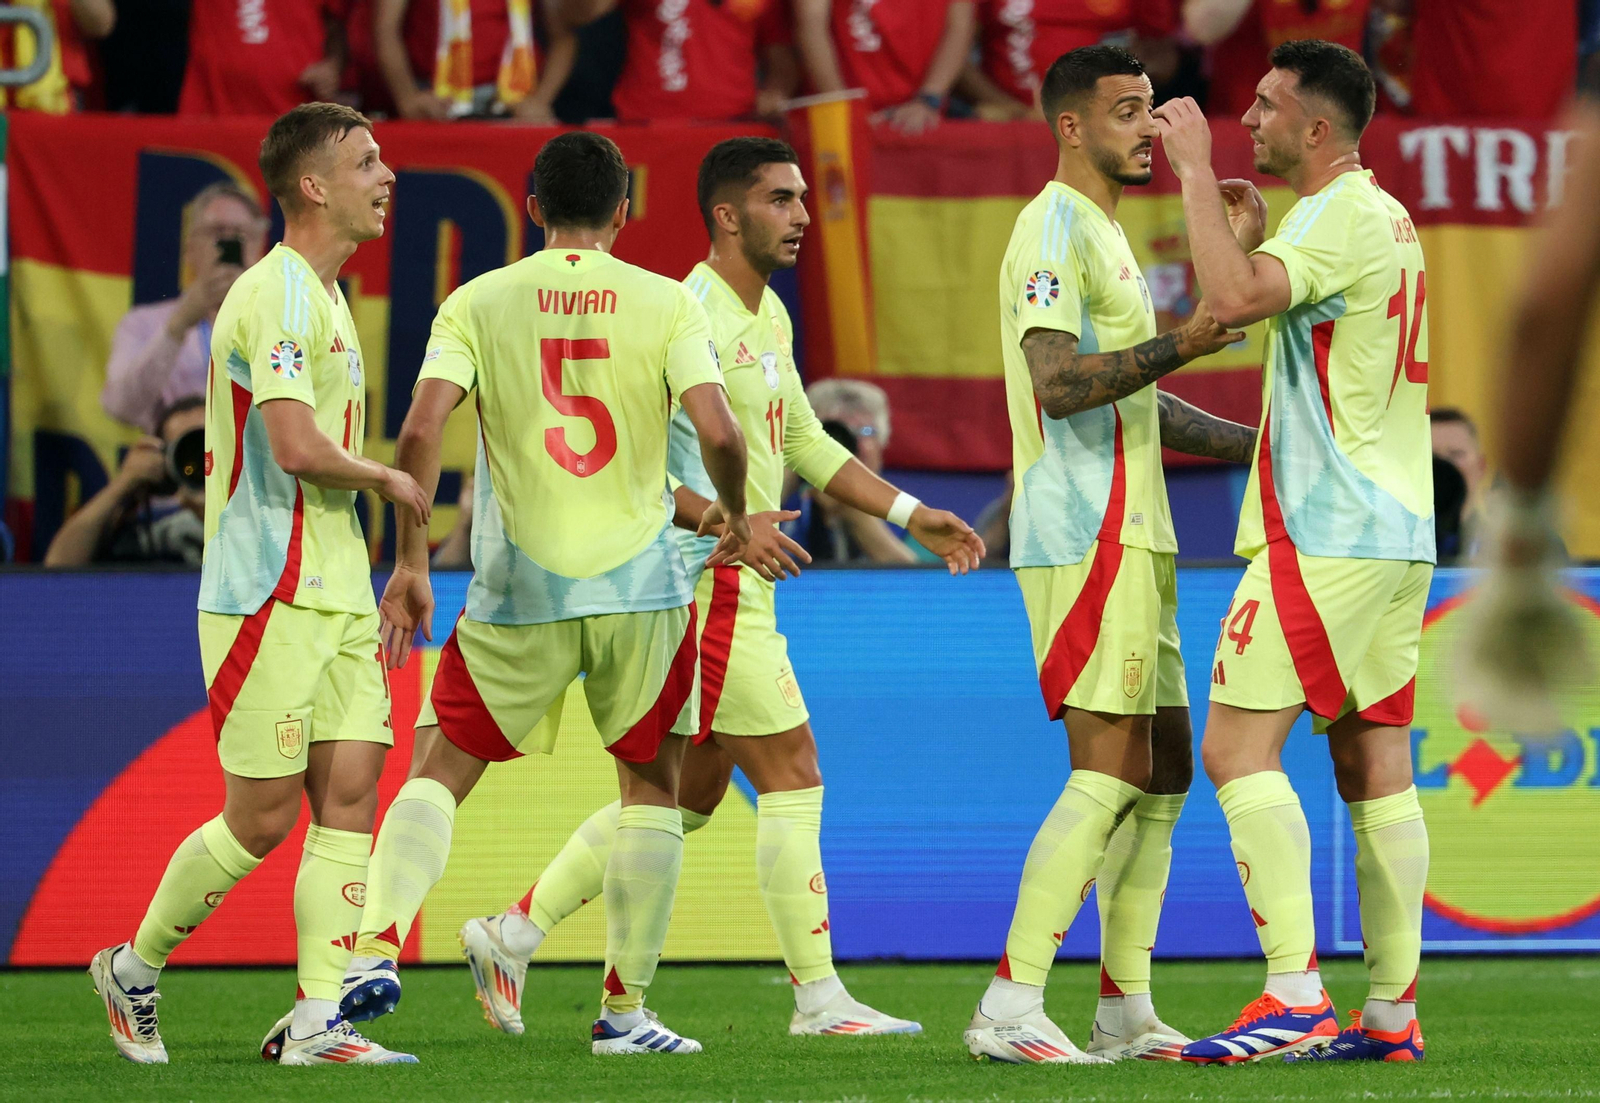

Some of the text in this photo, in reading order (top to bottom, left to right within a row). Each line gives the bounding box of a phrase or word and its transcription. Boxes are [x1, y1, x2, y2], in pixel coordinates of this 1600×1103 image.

[538, 288, 617, 315] VIVIAN
[540, 337, 618, 478] 5
[766, 398, 784, 455] 11
[994, 1031, 1039, 1041] F50
